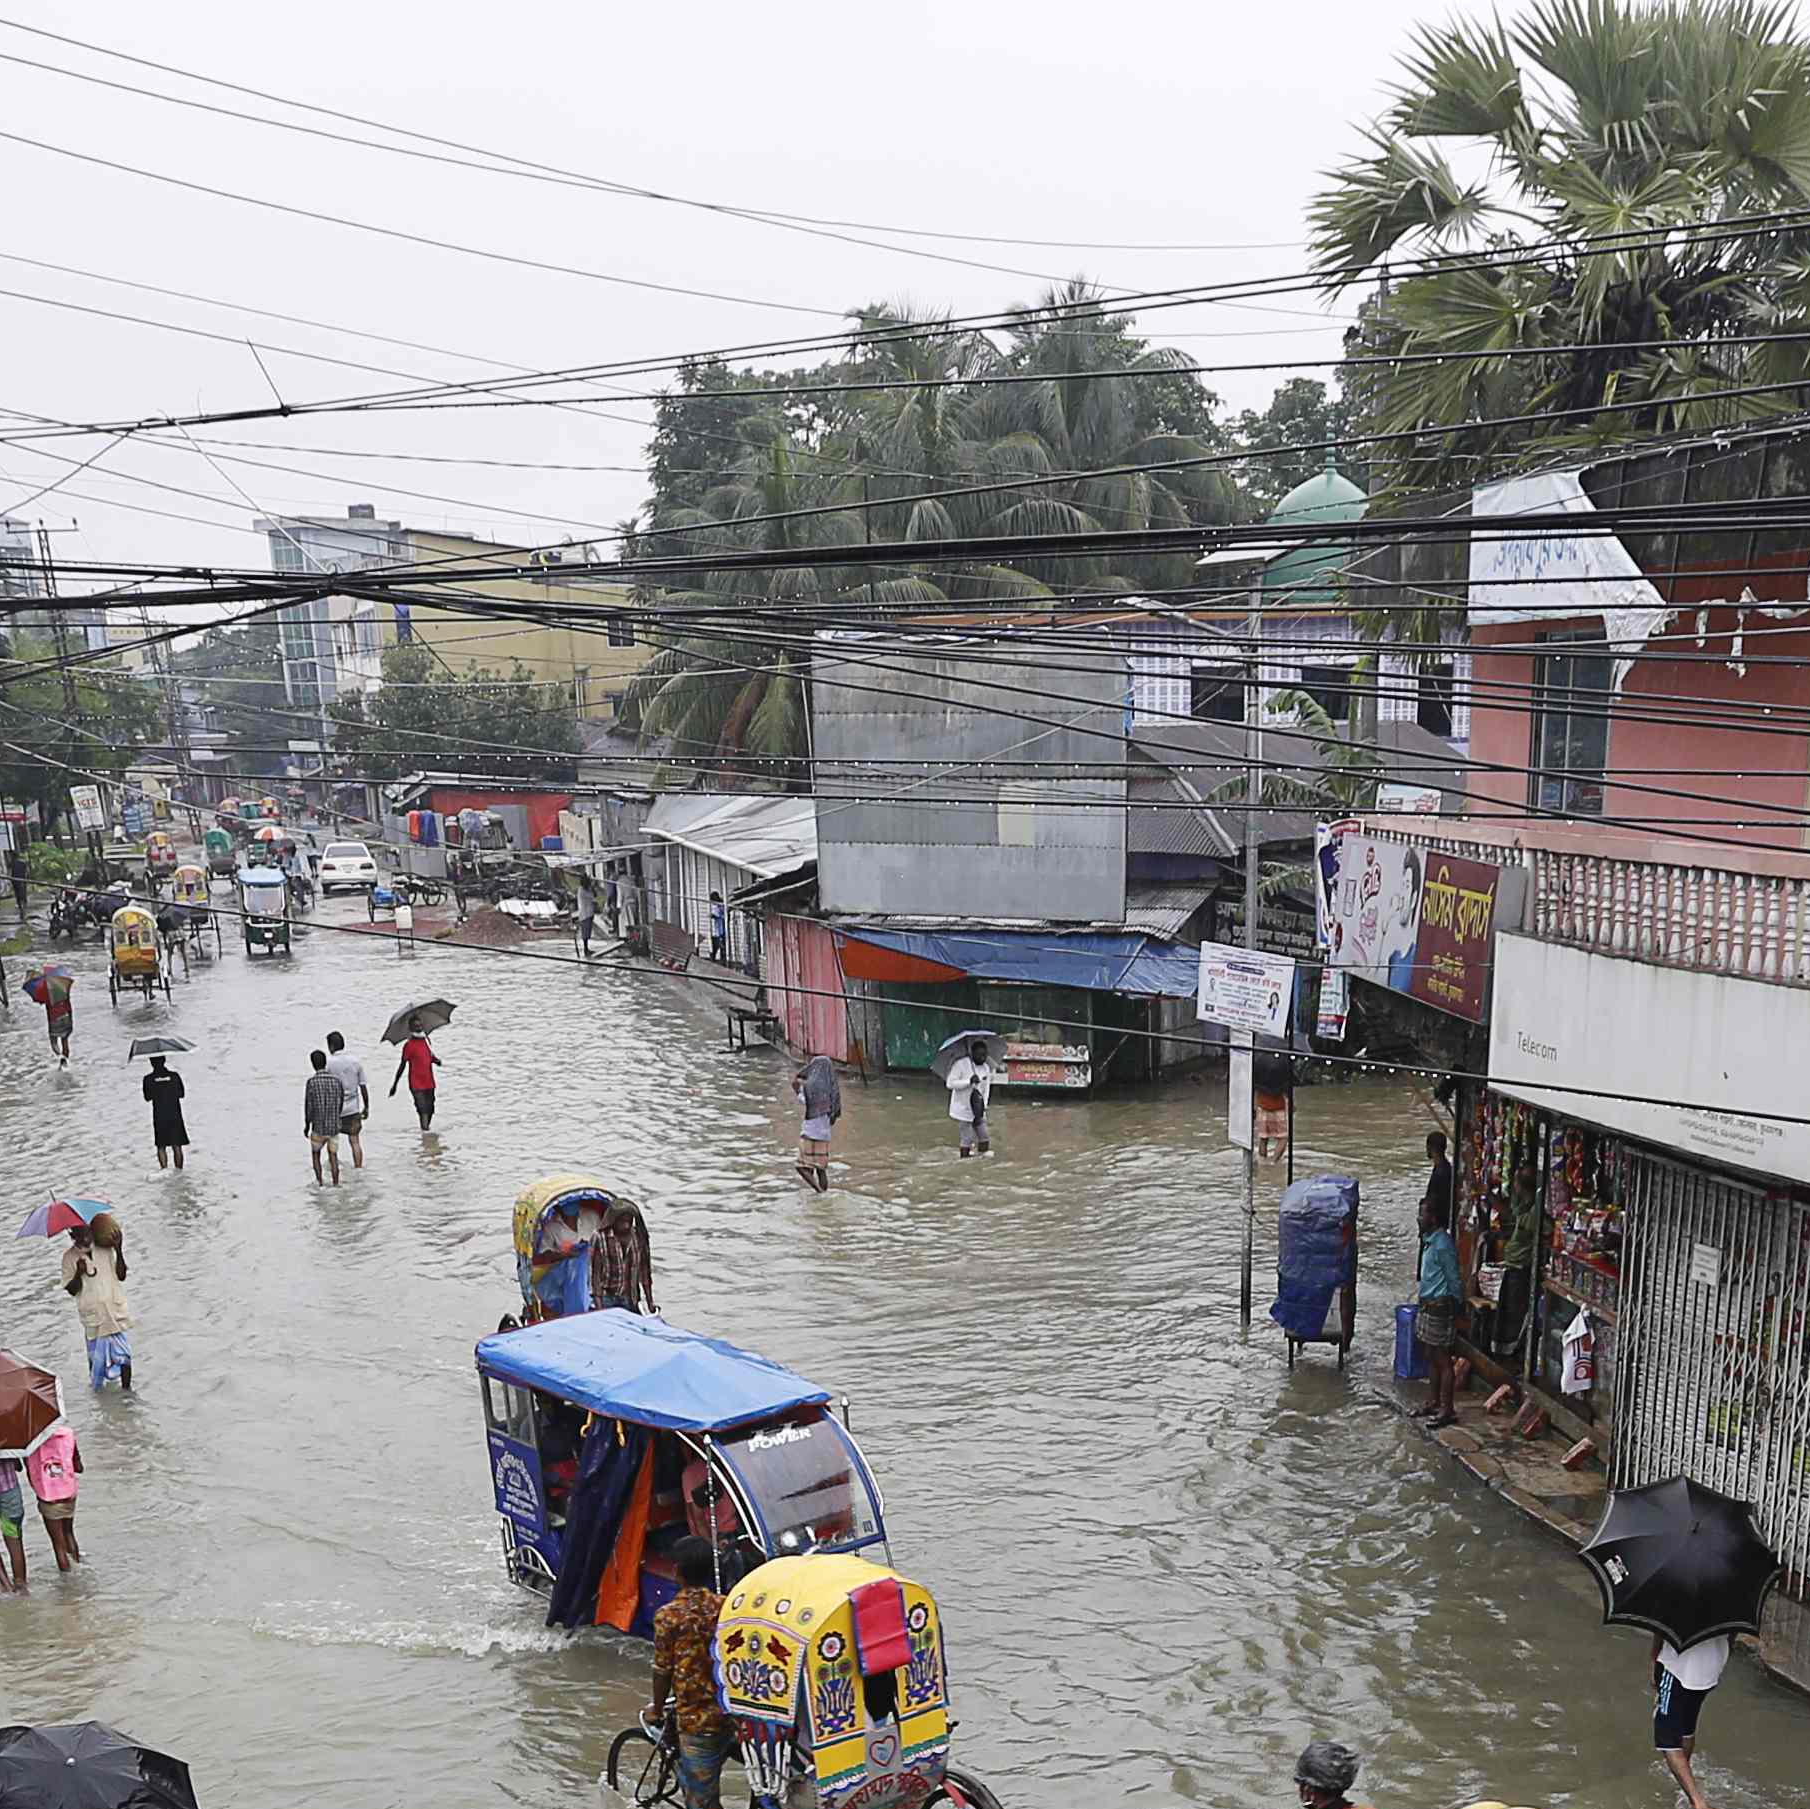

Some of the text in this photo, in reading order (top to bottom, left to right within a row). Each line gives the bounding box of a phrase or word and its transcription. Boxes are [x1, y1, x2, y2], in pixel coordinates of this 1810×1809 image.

[1422, 865, 1457, 931] নাসিম
[1455, 882, 1494, 944] ব্রাদার্স
[1517, 1031, 1558, 1062] Telecom
[748, 1424, 812, 1453] POWER
